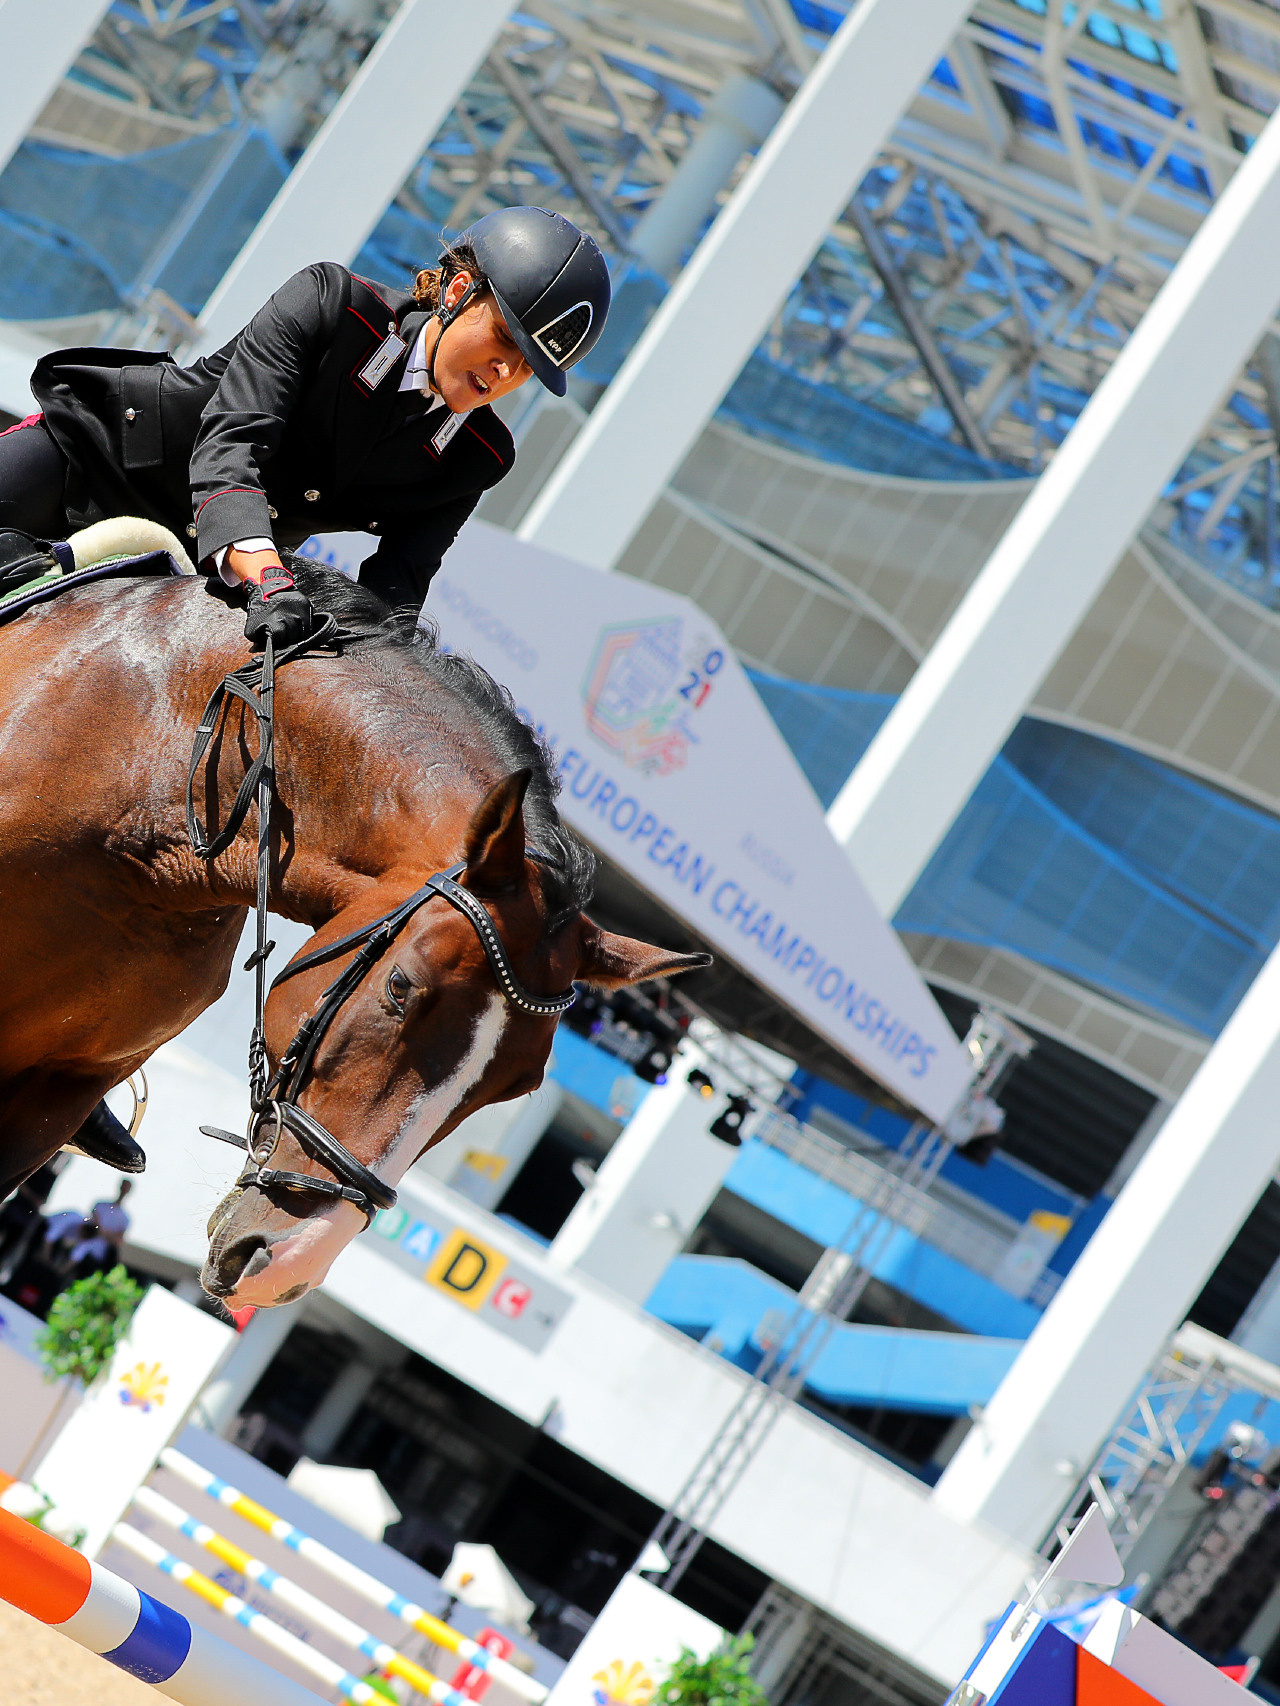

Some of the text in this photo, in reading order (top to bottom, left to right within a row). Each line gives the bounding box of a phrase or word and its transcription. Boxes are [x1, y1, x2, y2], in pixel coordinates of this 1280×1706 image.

[679, 670, 710, 707] 21
[558, 749, 937, 1077] EUROPEAN CHAMPIONSHIPS
[407, 1227, 437, 1260] A
[442, 1243, 487, 1292] D
